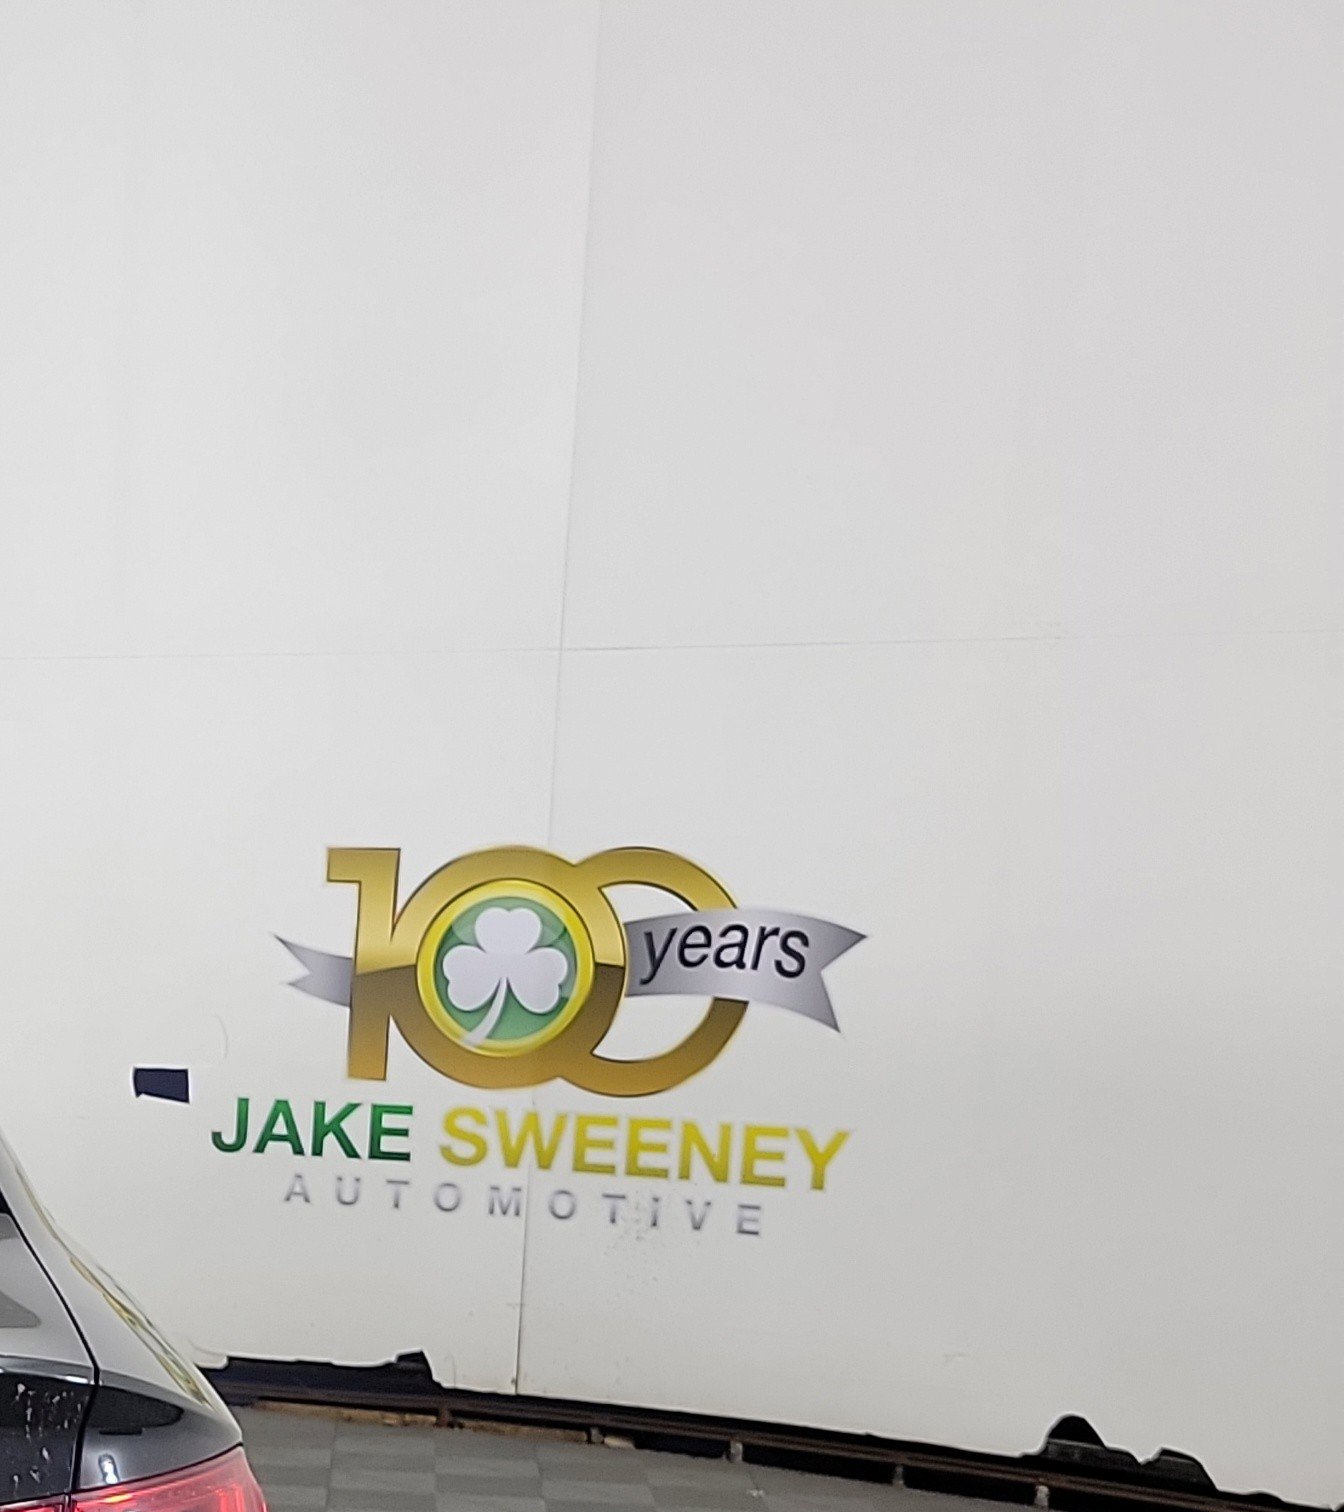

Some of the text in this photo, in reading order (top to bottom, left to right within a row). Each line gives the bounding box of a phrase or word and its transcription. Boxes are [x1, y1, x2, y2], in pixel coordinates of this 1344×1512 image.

[326, 846, 750, 1097] 100
[641, 921, 811, 985] years
[211, 1096, 850, 1192] JAKE SWEENEY
[284, 1173, 764, 1236] AUTOMOTIVE
